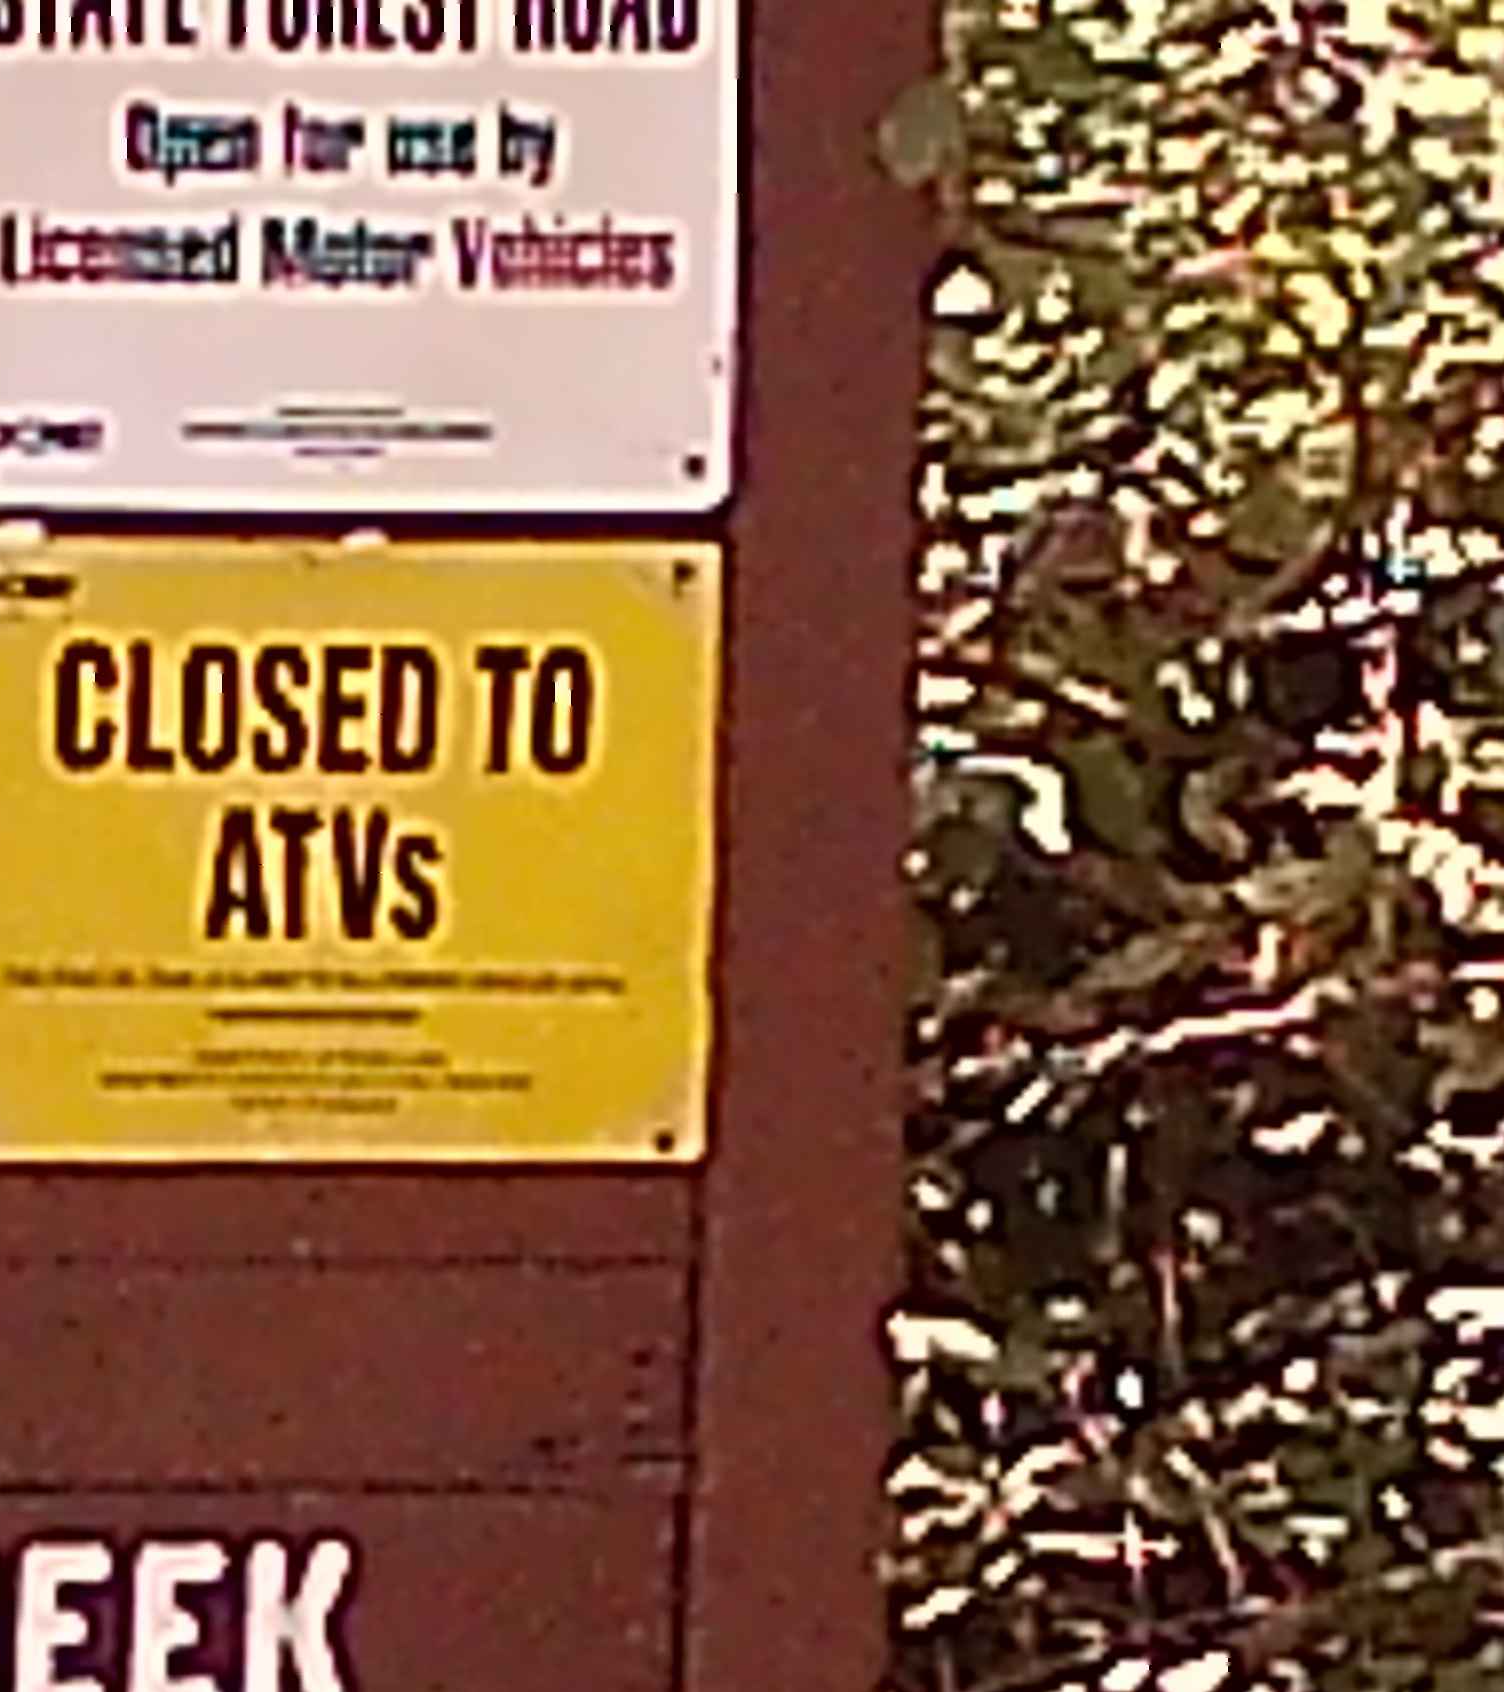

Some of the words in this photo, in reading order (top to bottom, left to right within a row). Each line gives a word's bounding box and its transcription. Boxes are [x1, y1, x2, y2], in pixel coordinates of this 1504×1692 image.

[498, 101, 556, 188] by
[0, 212, 240, 286] Licensed
[260, 217, 435, 290] Motor
[451, 212, 675, 290] Vehicles
[55, 640, 439, 774] CLOSED
[476, 645, 593, 774] TO
[205, 806, 441, 941] ATVs
